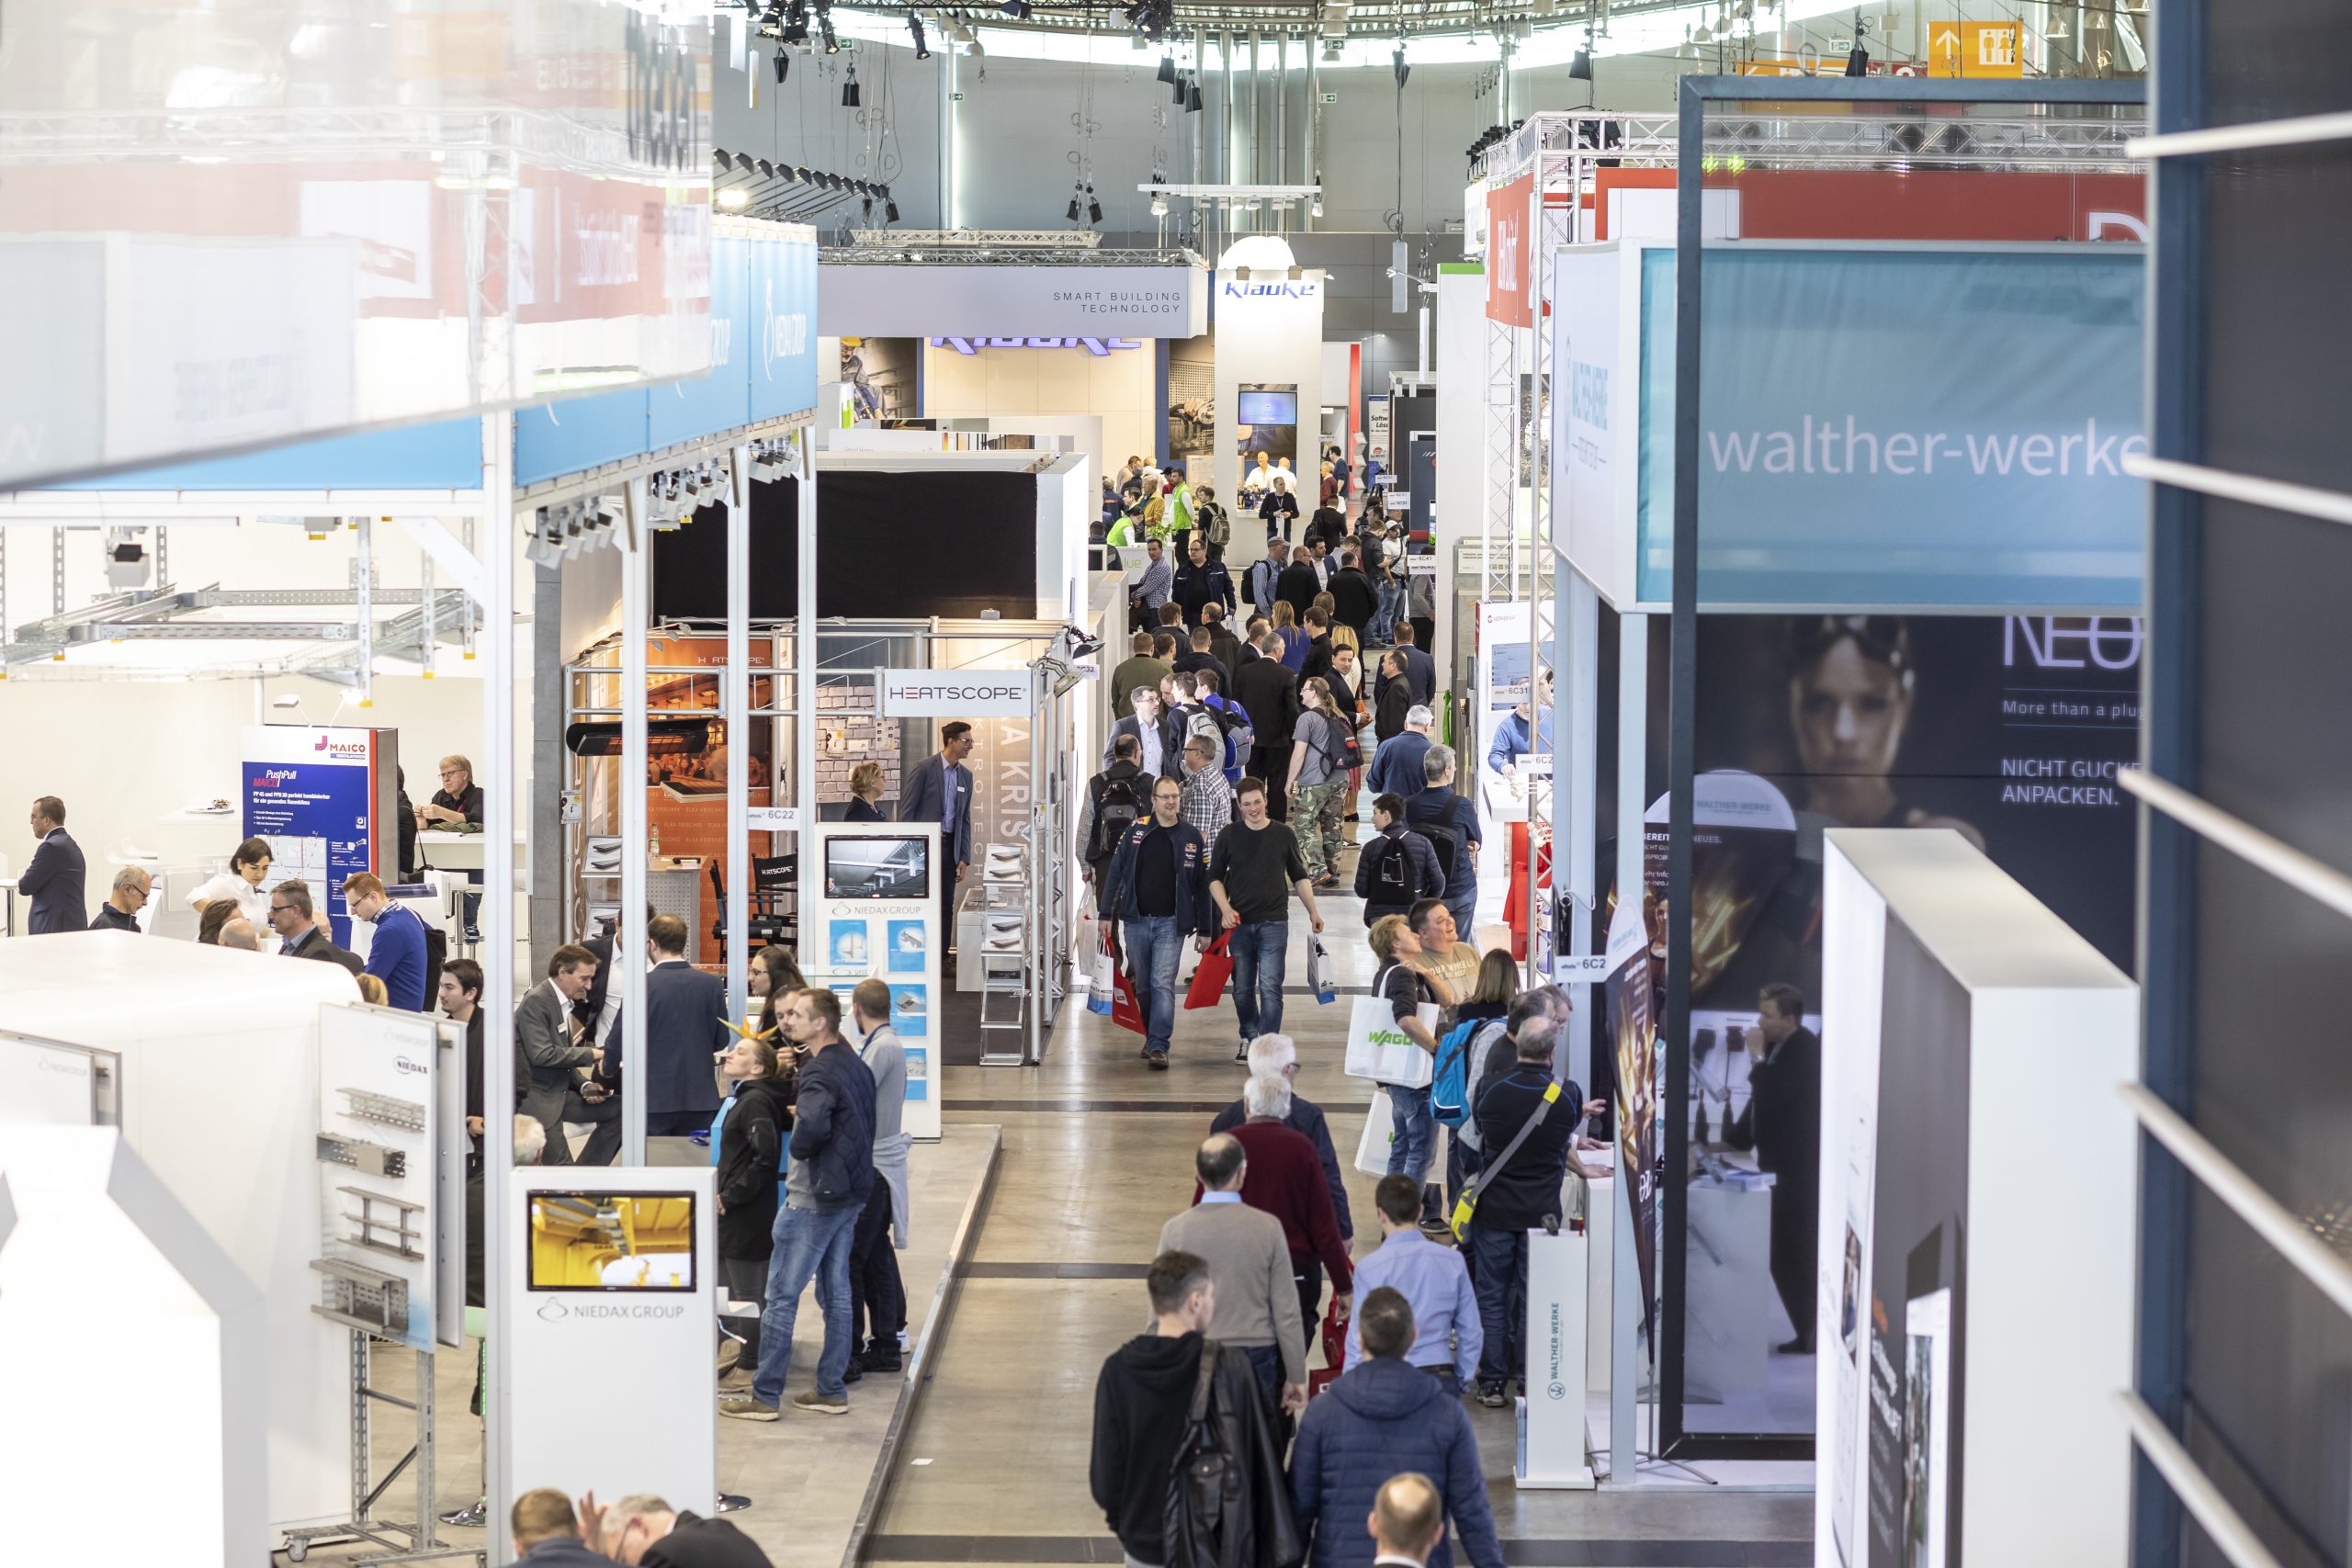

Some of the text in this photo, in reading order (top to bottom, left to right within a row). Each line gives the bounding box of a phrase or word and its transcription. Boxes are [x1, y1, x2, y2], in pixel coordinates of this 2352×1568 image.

[1053, 292, 1181, 301] SMART BUILDING
[1225, 282, 1315, 299] Klauke
[1081, 304, 1181, 313] TECHNOLOGY
[2003, 700, 2044, 716] More
[2052, 702, 2088, 716] than
[2096, 705, 2105, 716] a
[330, 743, 366, 753] MAICO
[1535, 756, 1554, 764] 6C2
[2003, 759, 2066, 777] NICHT
[266, 769, 297, 782] PushPull
[2002, 784, 2120, 806] ANPACKEN.
[768, 809, 795, 819] 6C22
[854, 906, 922, 915] NIEDAX GROUP
[1582, 958, 1606, 969] 6C2
[396, 1060, 428, 1075] NIEDAX
[574, 1305, 684, 1319] NIEDAX GROUP
[1550, 1302, 1560, 1380] WALTHER-WERKE
